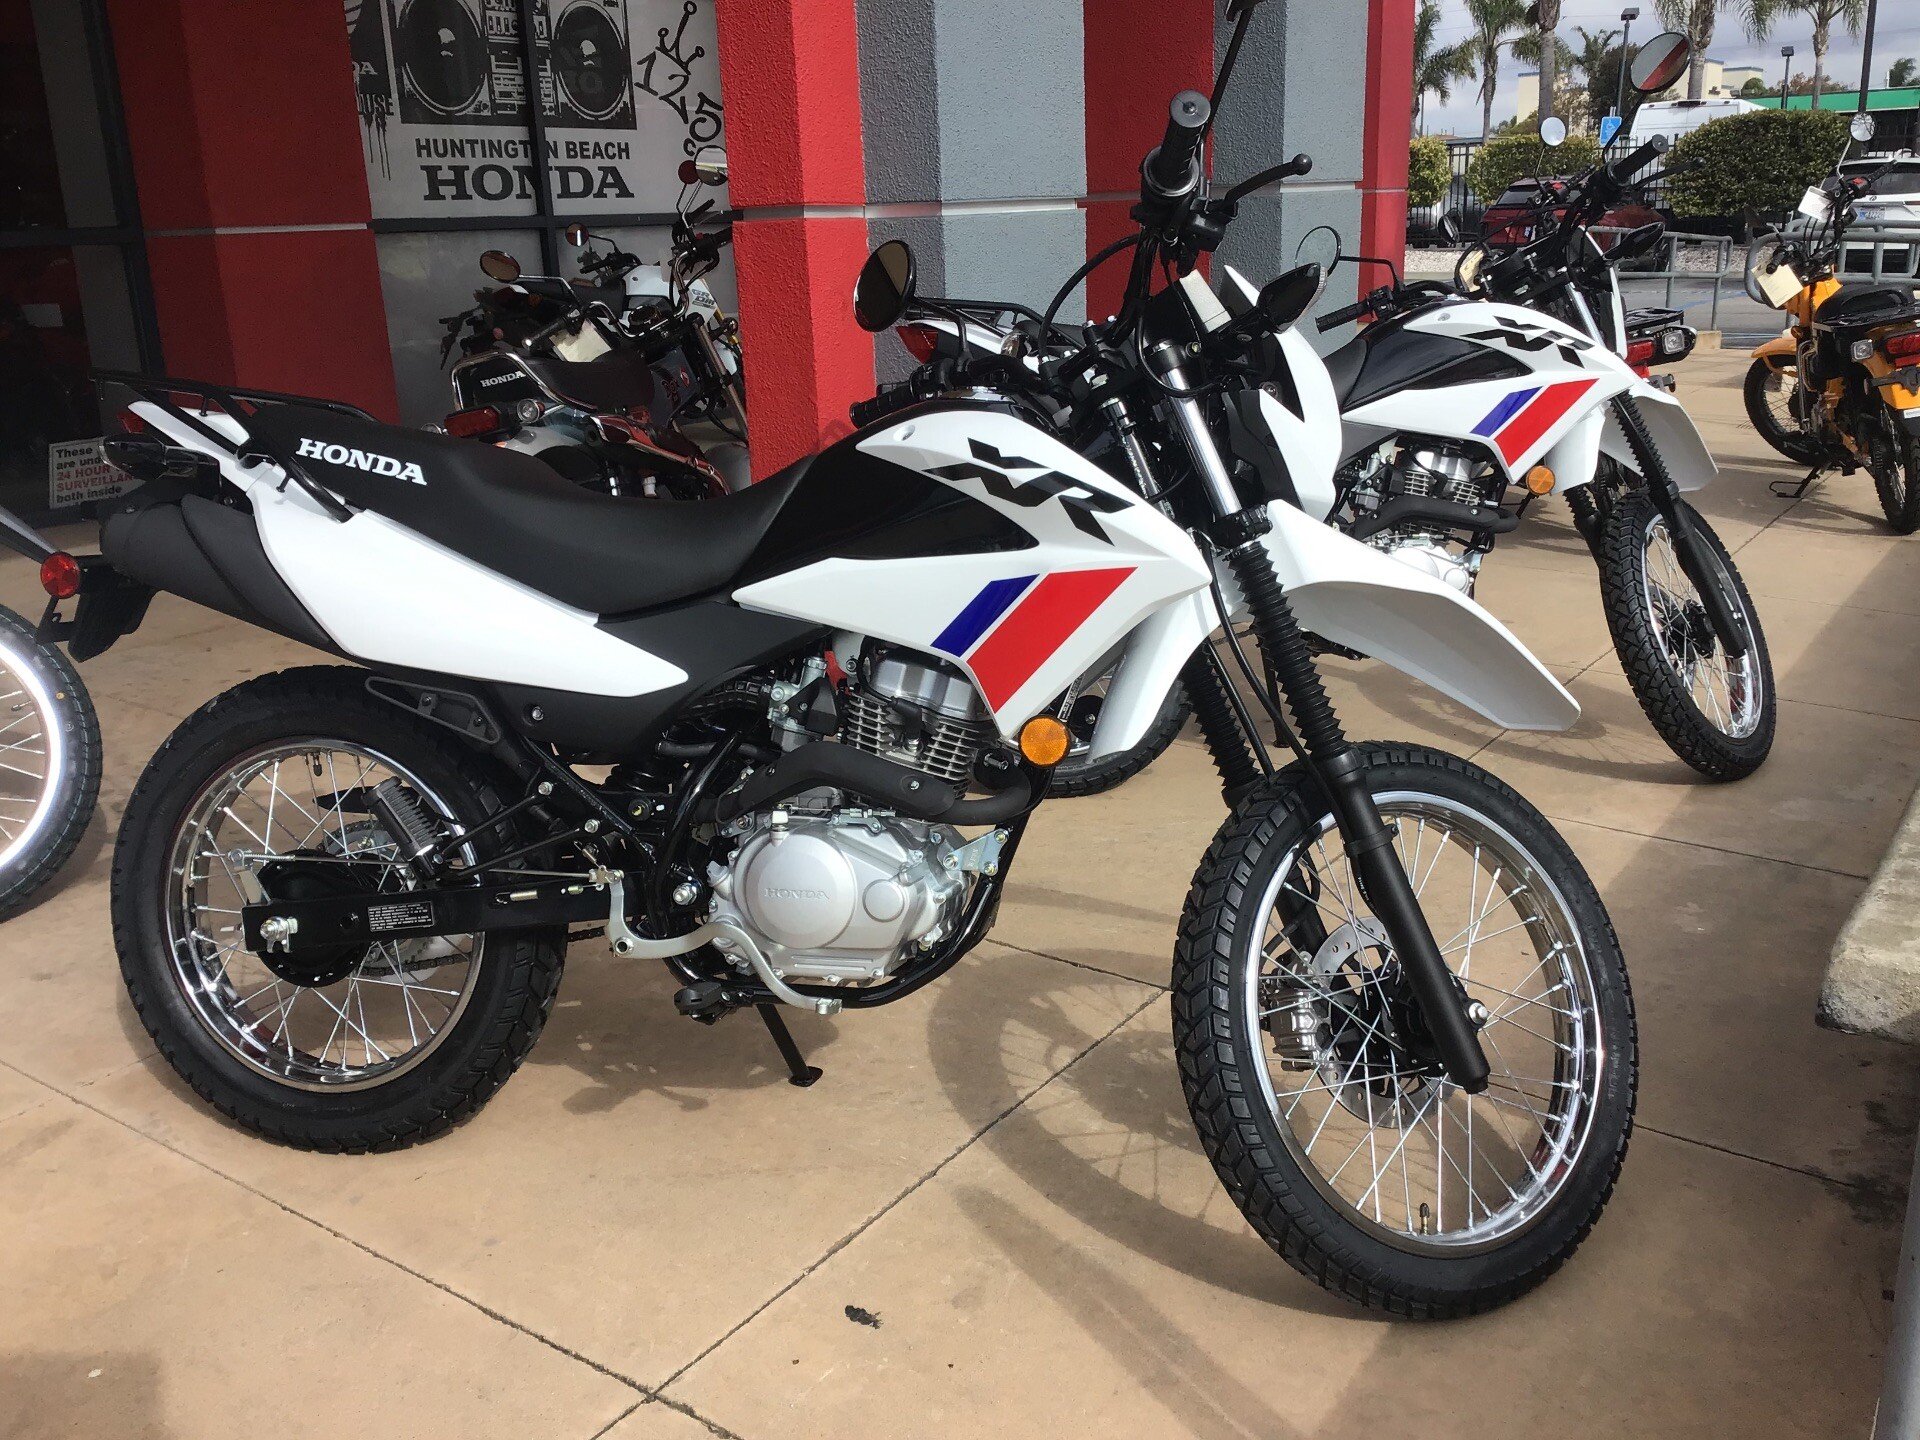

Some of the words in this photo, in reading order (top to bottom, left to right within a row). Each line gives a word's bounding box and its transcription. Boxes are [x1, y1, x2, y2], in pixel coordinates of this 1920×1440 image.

[415, 138, 559, 159] HUNTINGTN
[565, 141, 631, 160] BEACH
[480, 371, 526, 387] HONDA
[56, 447, 93, 459] These
[56, 460, 76, 470] are
[295, 437, 428, 486] HONDA
[57, 471, 71, 480] 24
[75, 465, 110, 478] HOUR
[56, 492, 83, 503] both
[87, 485, 122, 498] inside
[764, 888, 830, 901] HONDA
